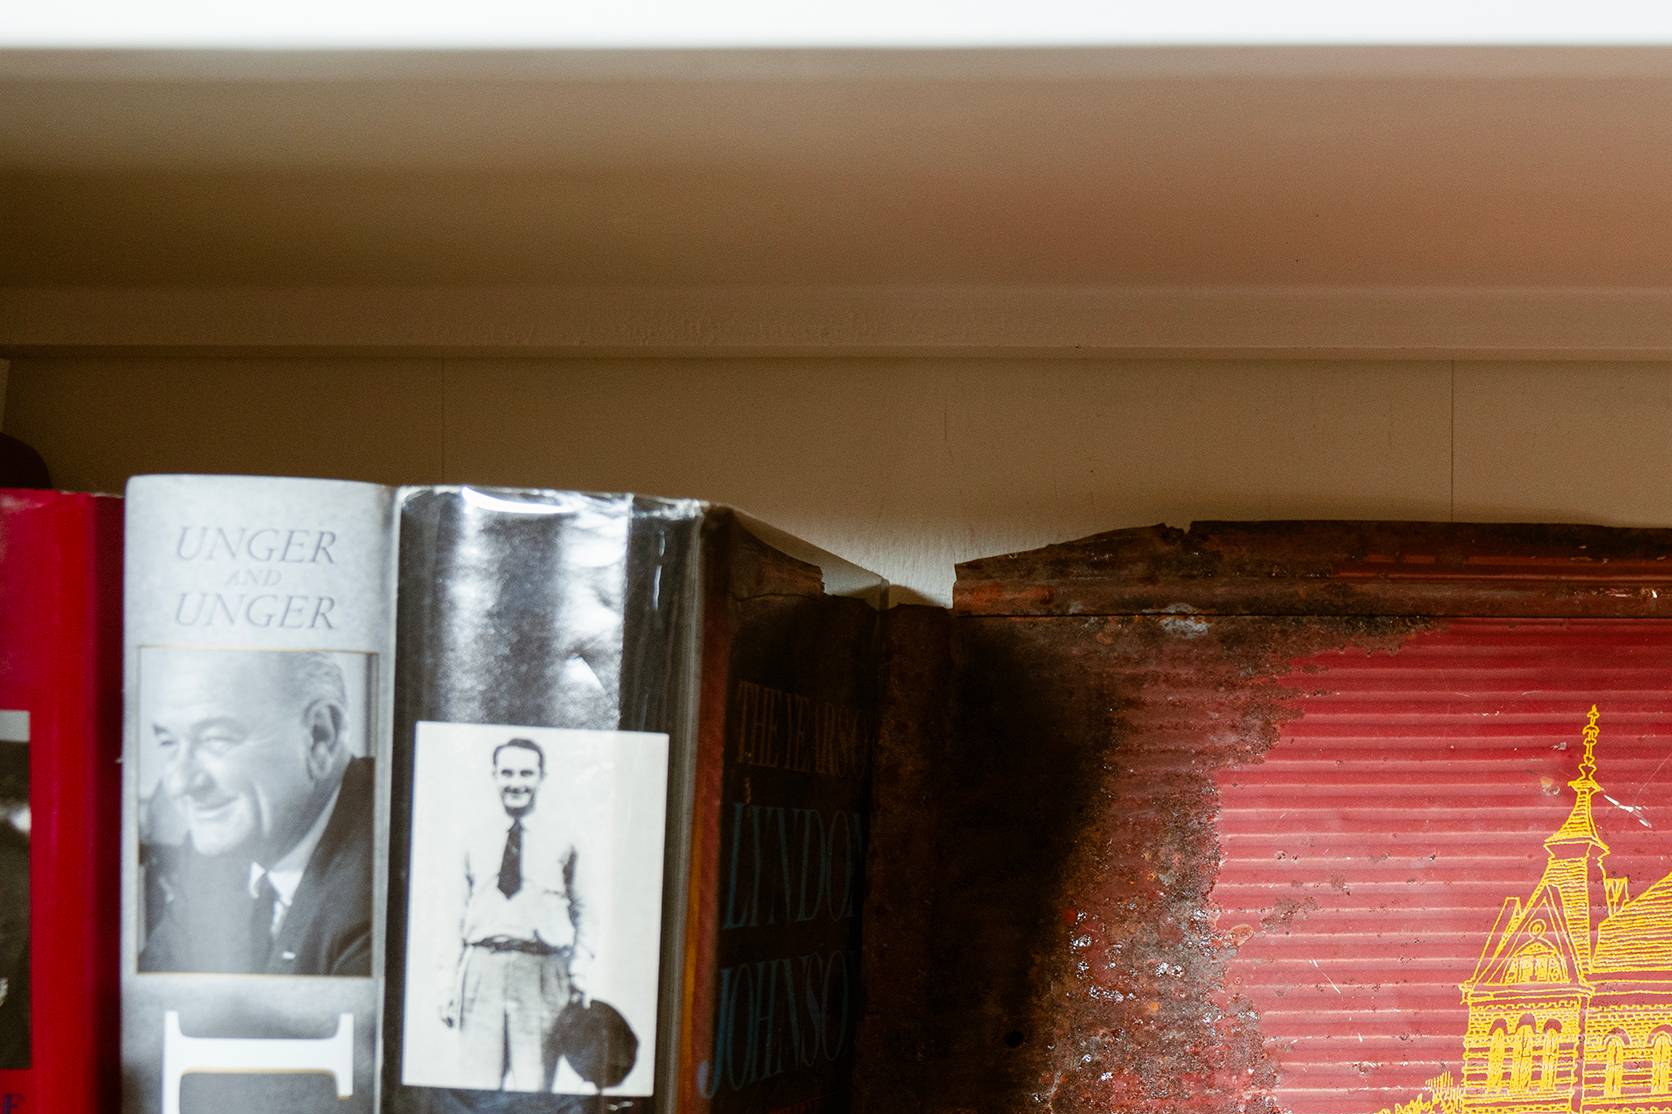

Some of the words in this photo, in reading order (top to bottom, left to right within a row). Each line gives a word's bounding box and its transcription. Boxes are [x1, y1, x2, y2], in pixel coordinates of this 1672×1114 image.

[175, 525, 337, 566] UNGER
[224, 567, 282, 588] AND
[173, 592, 336, 631] UNGER
